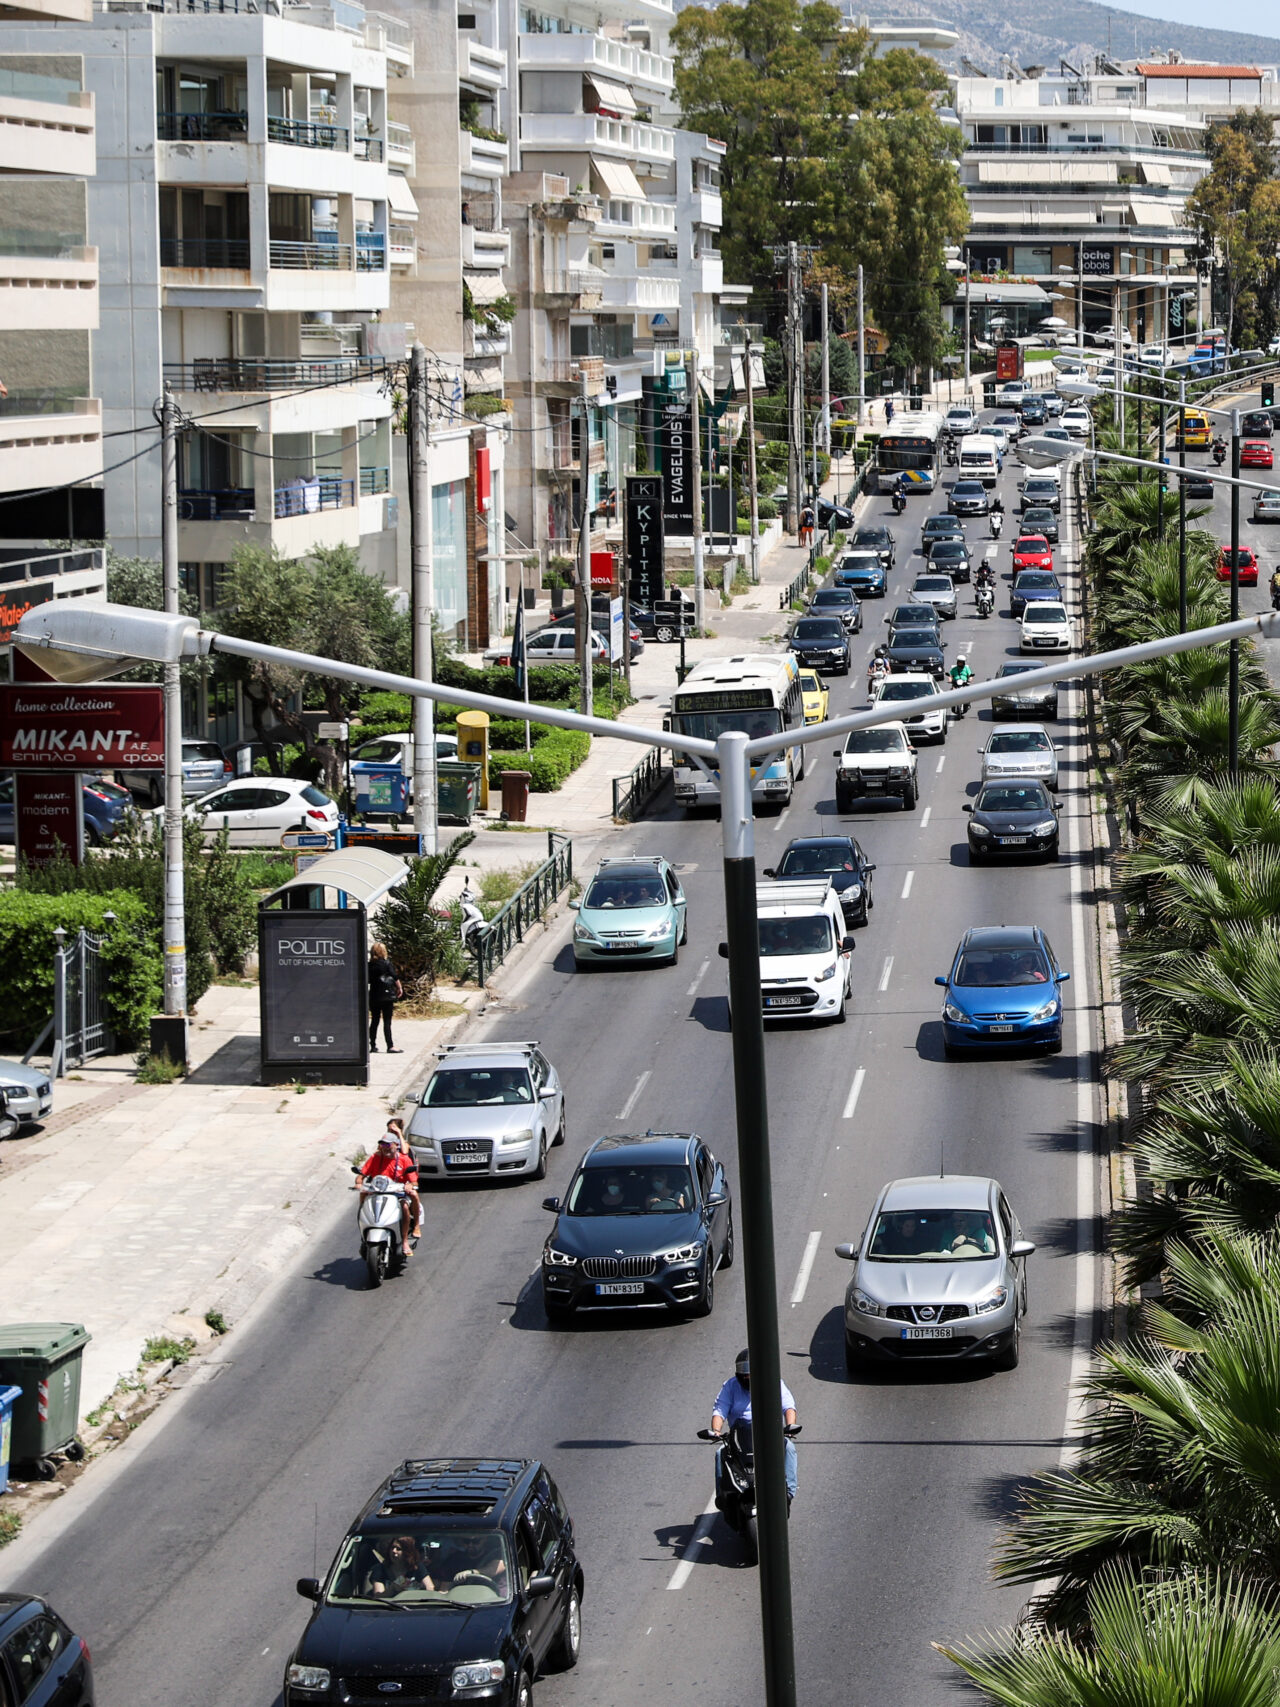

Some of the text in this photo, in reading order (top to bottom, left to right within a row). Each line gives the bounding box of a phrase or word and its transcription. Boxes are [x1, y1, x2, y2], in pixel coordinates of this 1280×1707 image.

[671, 421, 683, 504] EVAGELIDIS
[15, 696, 116, 712] home collection
[22, 804, 70, 816] modern
[39, 823, 50, 835] &
[278, 940, 345, 955] POLITIS
[303, 959, 322, 967] HOME
[324, 959, 345, 967] MEDIA
